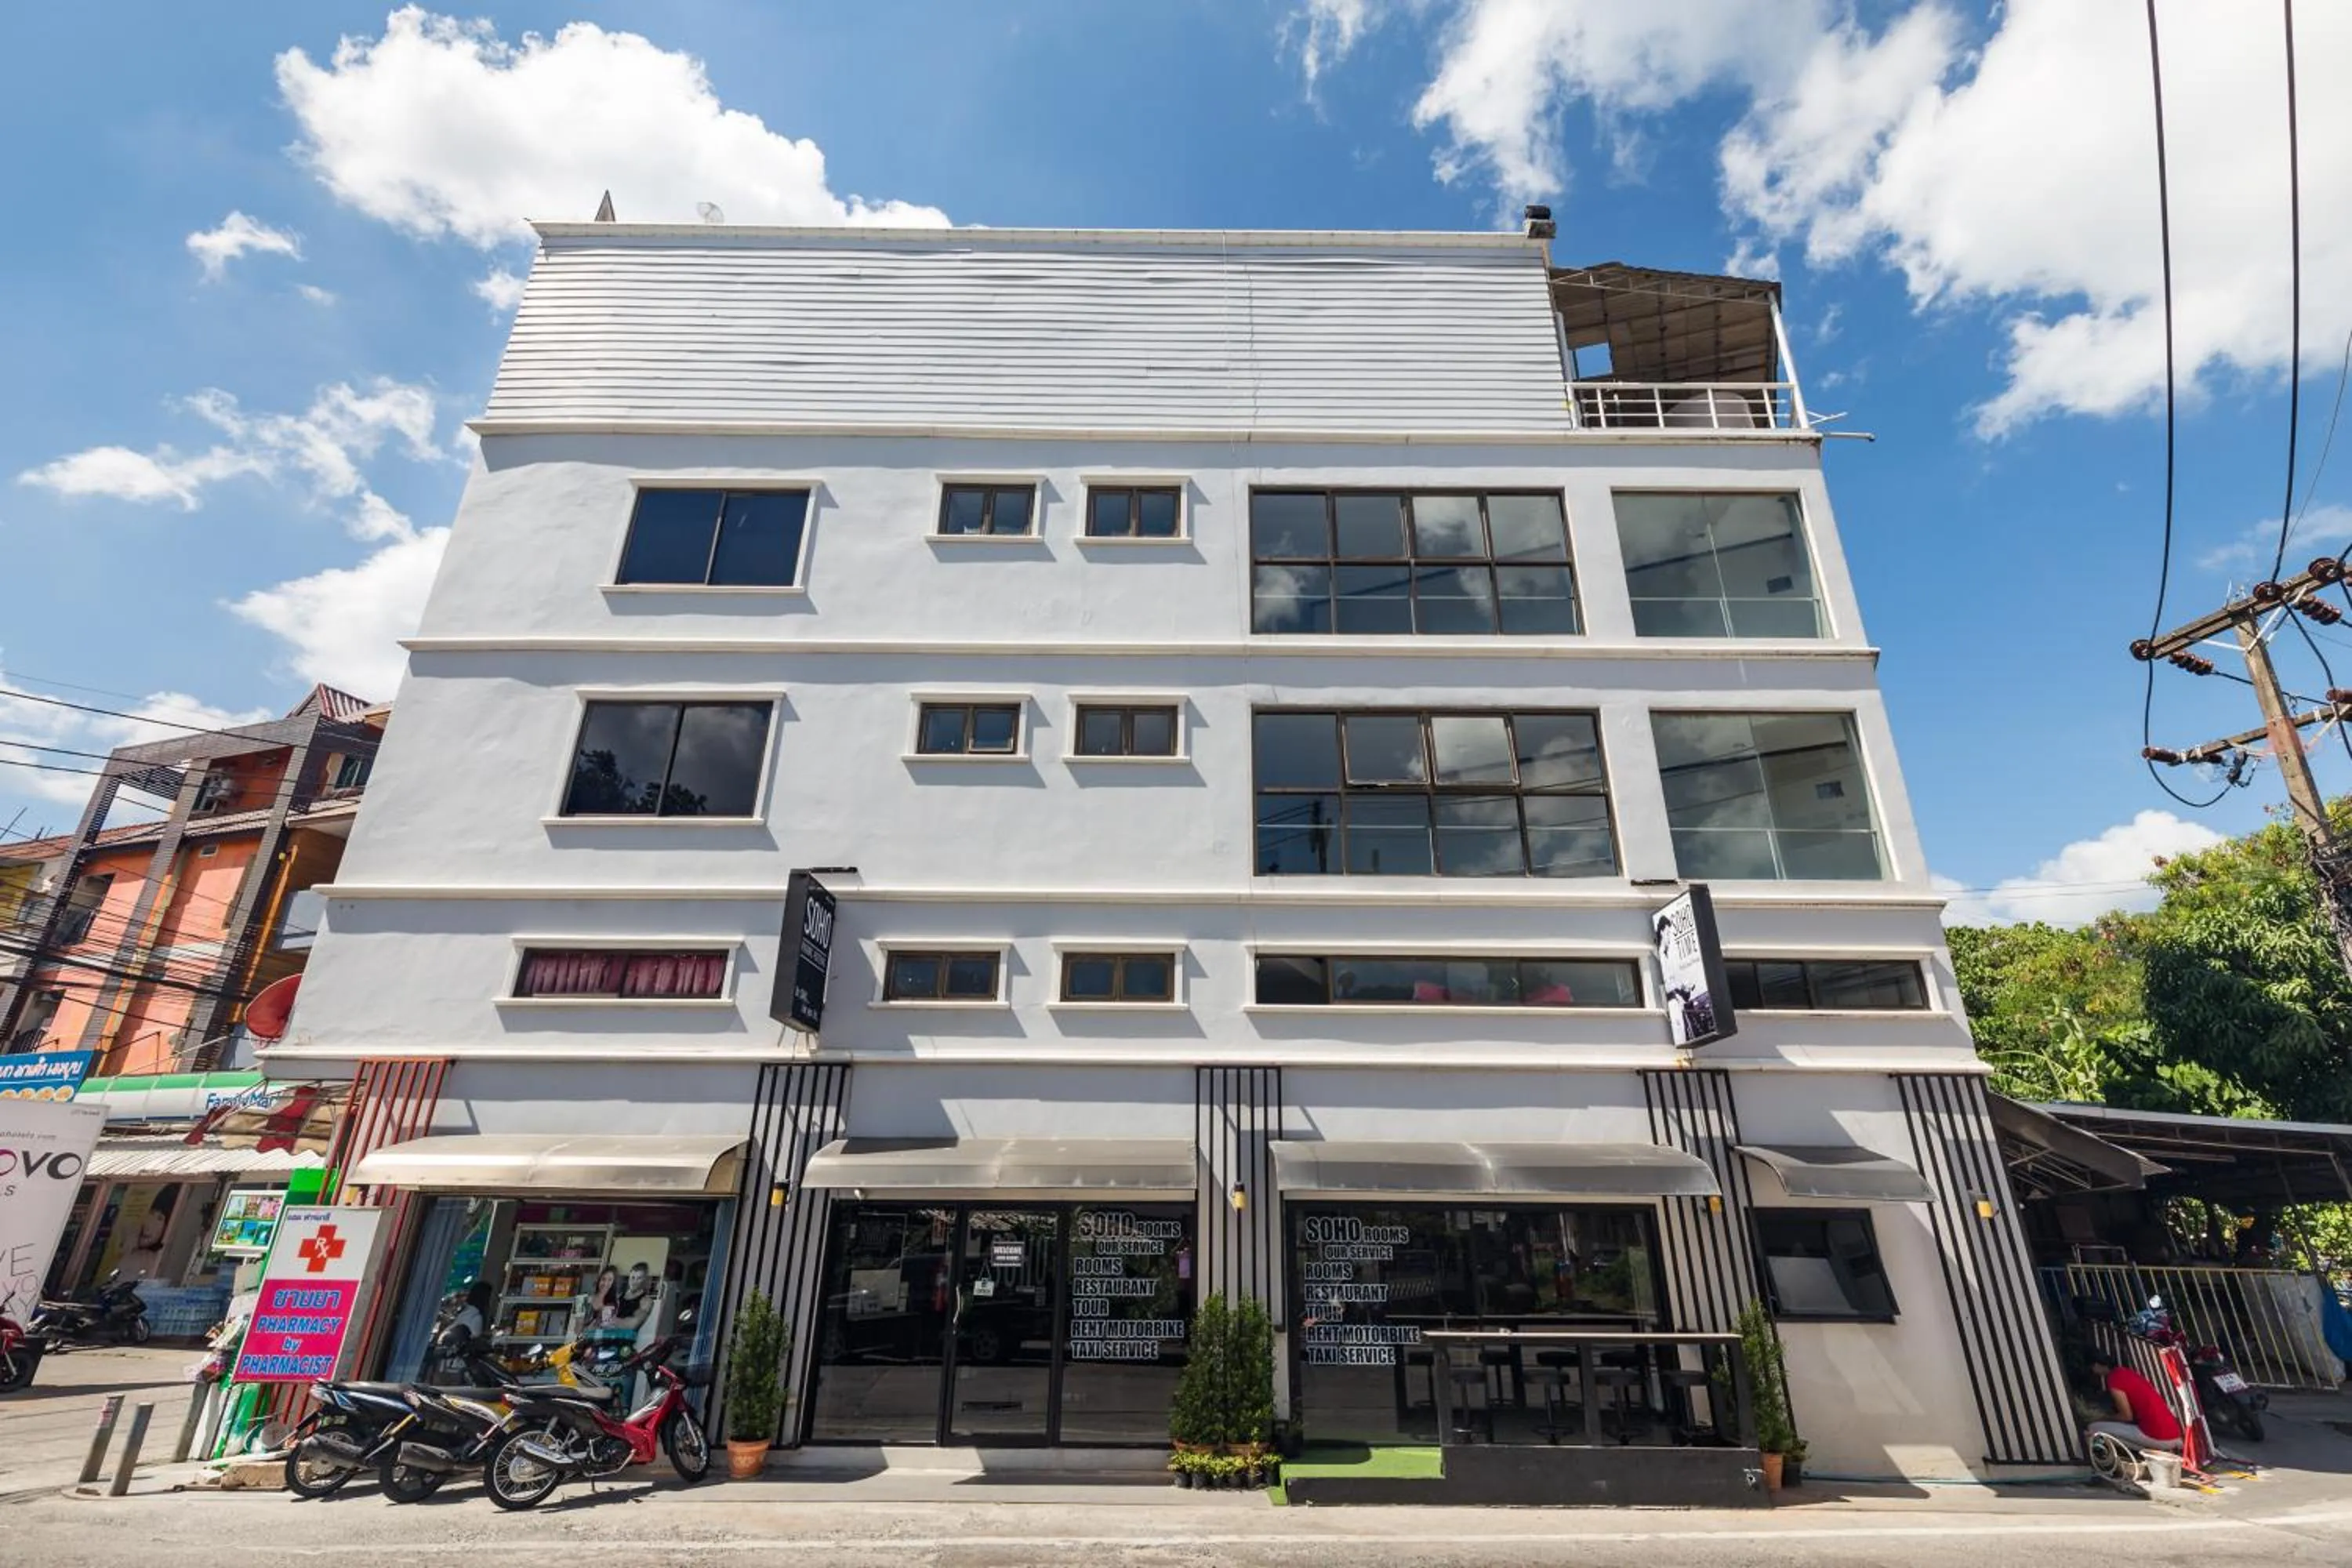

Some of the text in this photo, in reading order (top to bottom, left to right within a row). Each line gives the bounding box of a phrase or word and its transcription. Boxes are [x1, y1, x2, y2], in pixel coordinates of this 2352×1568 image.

[804, 896, 832, 949] SOHO
[1079, 1212, 1181, 1238] SOHO ROOMS
[1305, 1217, 1409, 1243] SOHO ROOMS
[1098, 1240, 1164, 1254] OUR SERVICE
[1325, 1245, 1392, 1260] OUR SERVICE
[1074, 1258, 1122, 1274] ROOMS
[1305, 1262, 1352, 1279] ROOMS
[1073, 1279, 1156, 1295] RESTAURANT
[1305, 1284, 1388, 1301] RESTAURANT
[1073, 1298, 1109, 1316] TOUR
[1306, 1304, 1342, 1321] TOUR
[256, 1316, 342, 1334] PHARMACY
[1071, 1320, 1184, 1338] RENT MOTORBIKE
[1305, 1325, 1420, 1344] RENT MOTORBIKE
[282, 1337, 303, 1353] by
[1071, 1340, 1159, 1359] TAXI SERVICE
[1339, 1347, 1396, 1364] SERVICE
[240, 1355, 334, 1375] PHARMACIST
